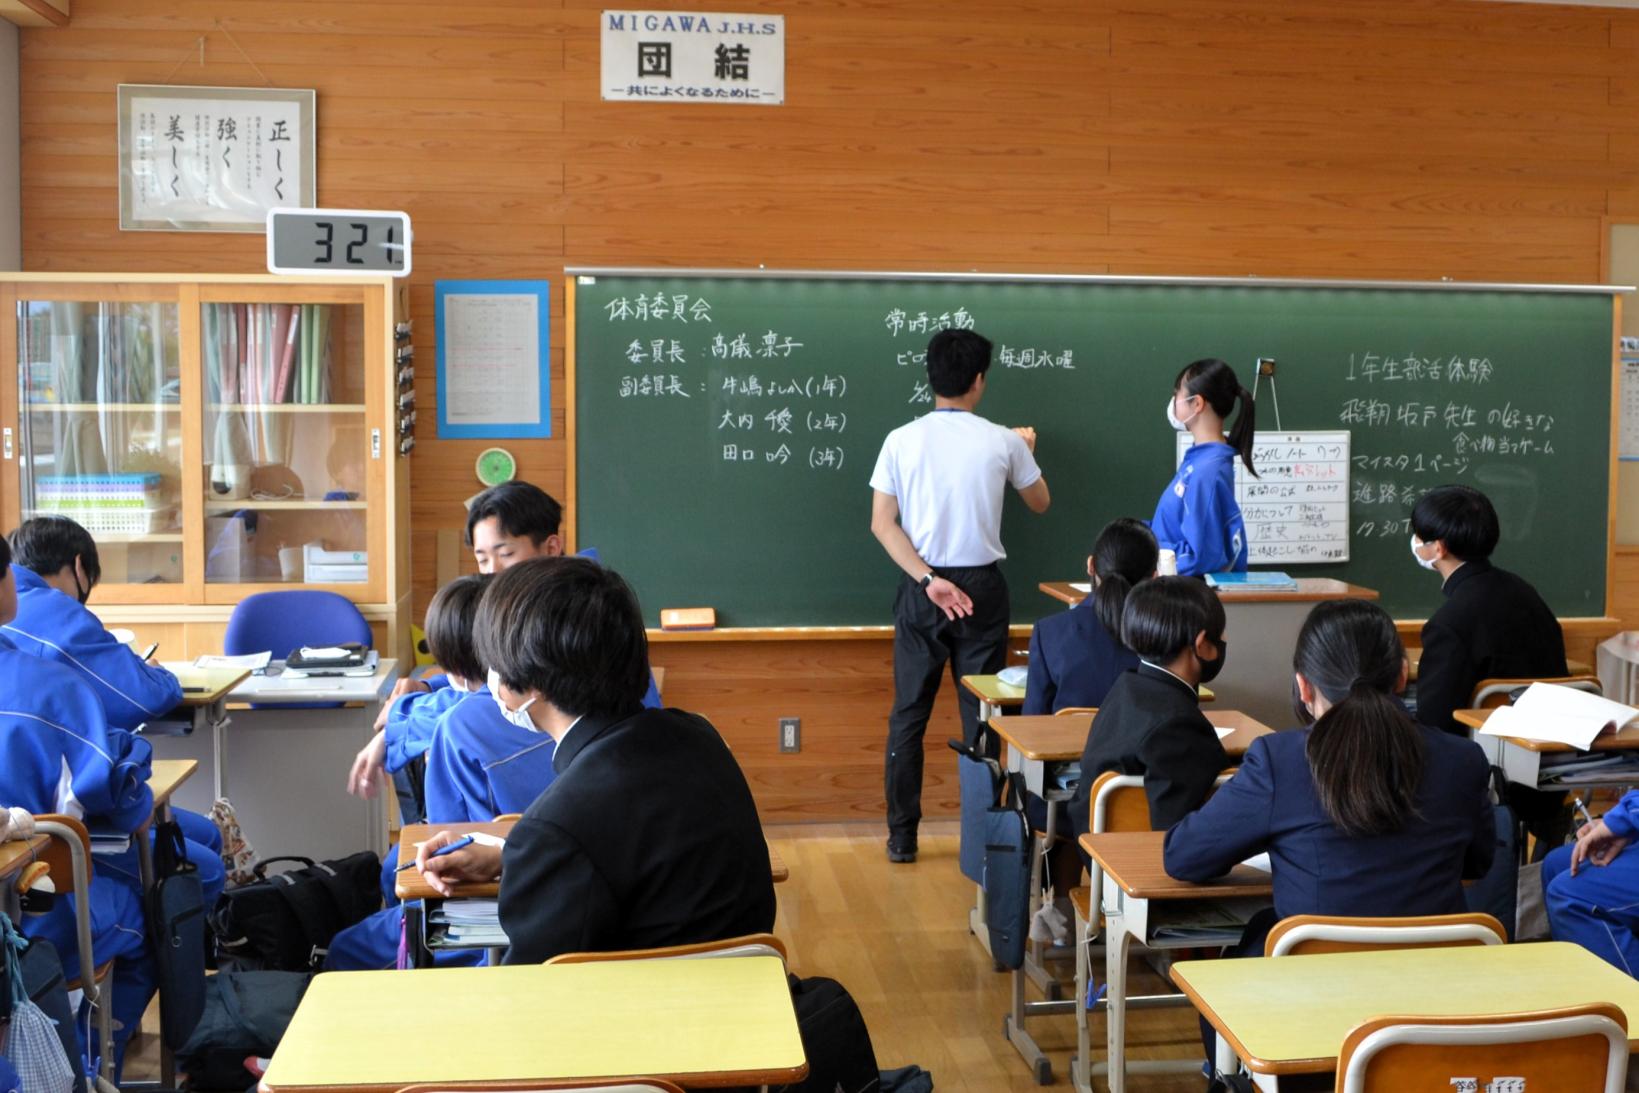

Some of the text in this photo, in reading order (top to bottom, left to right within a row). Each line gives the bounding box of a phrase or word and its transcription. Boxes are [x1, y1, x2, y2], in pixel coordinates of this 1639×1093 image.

[609, 14, 711, 33] MIGAWA
[164, 113, 185, 198] 美しく
[217, 116, 238, 169] 強く
[269, 119, 291, 201] 正しく
[604, 291, 713, 324] 体育委員会
[884, 306, 976, 338] 常時活動
[625, 338, 687, 364] 委員長
[619, 374, 691, 398] 副委員長
[1352, 480, 1434, 507] 進路希
